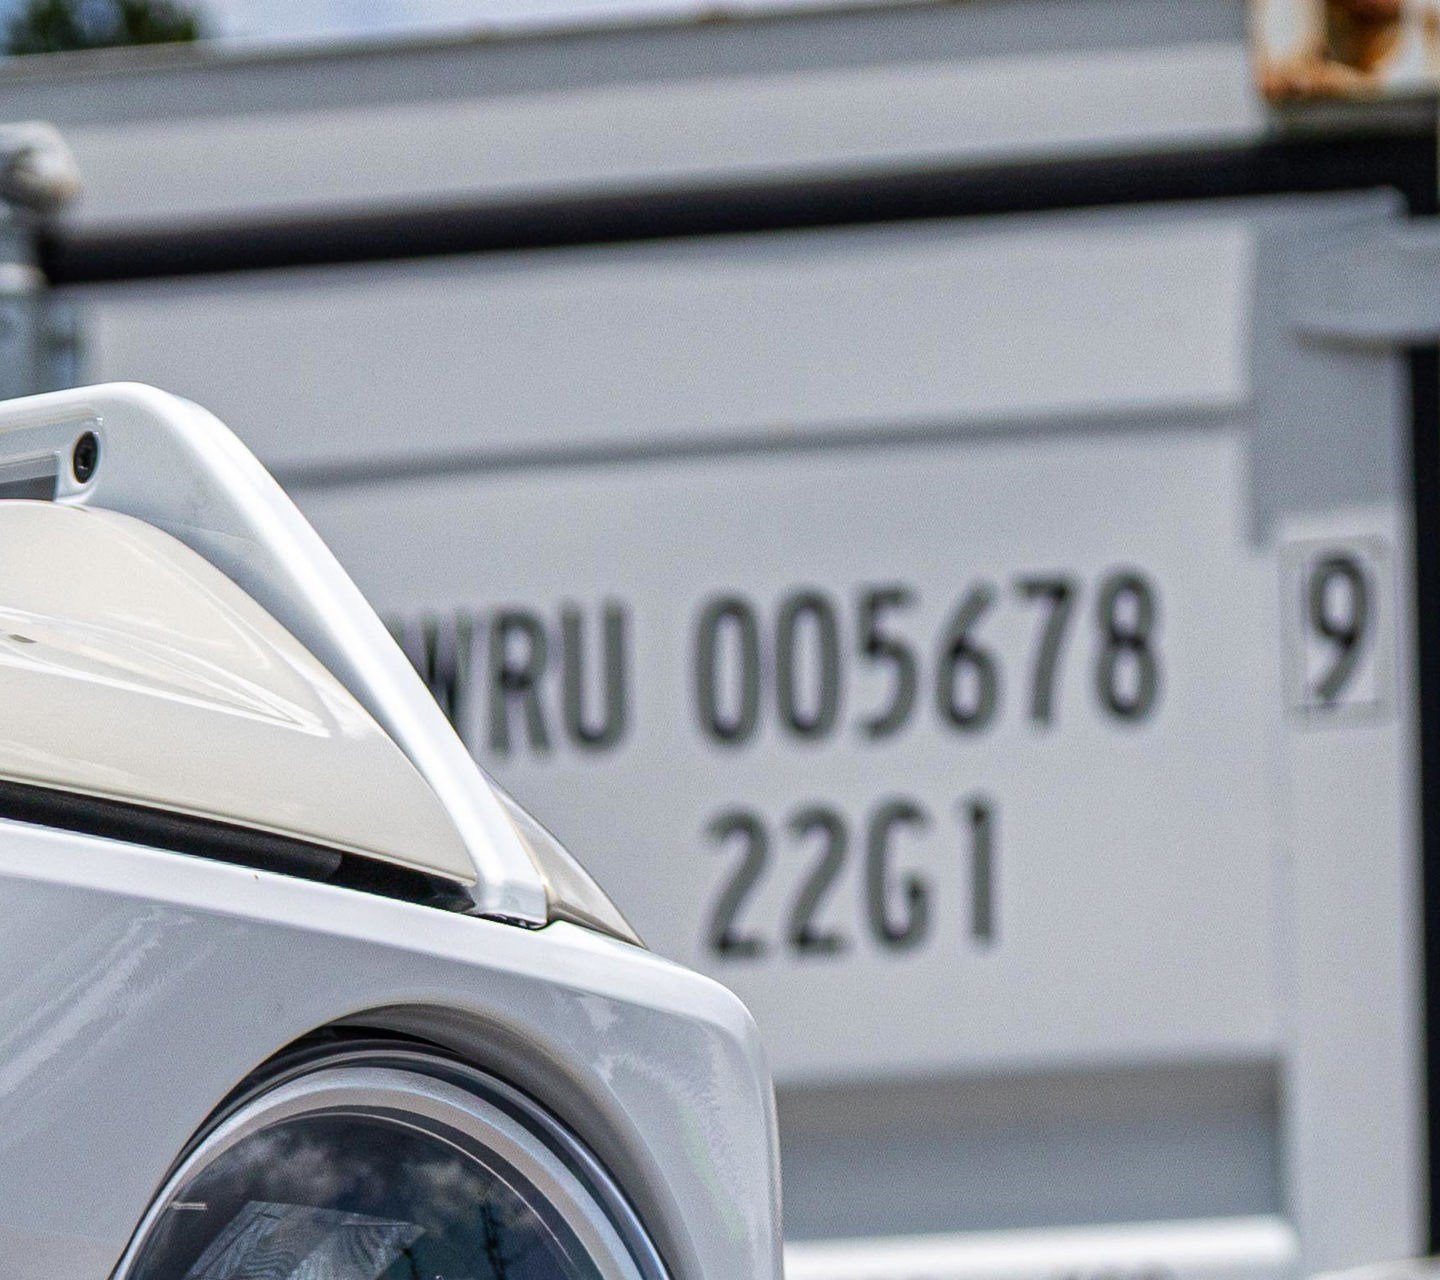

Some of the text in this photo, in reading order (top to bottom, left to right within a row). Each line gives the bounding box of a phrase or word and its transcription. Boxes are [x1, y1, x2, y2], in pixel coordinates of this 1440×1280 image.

[692, 564, 1162, 750] 005678
[1300, 552, 1376, 708] 9
[704, 794, 1000, 960] 22G1
